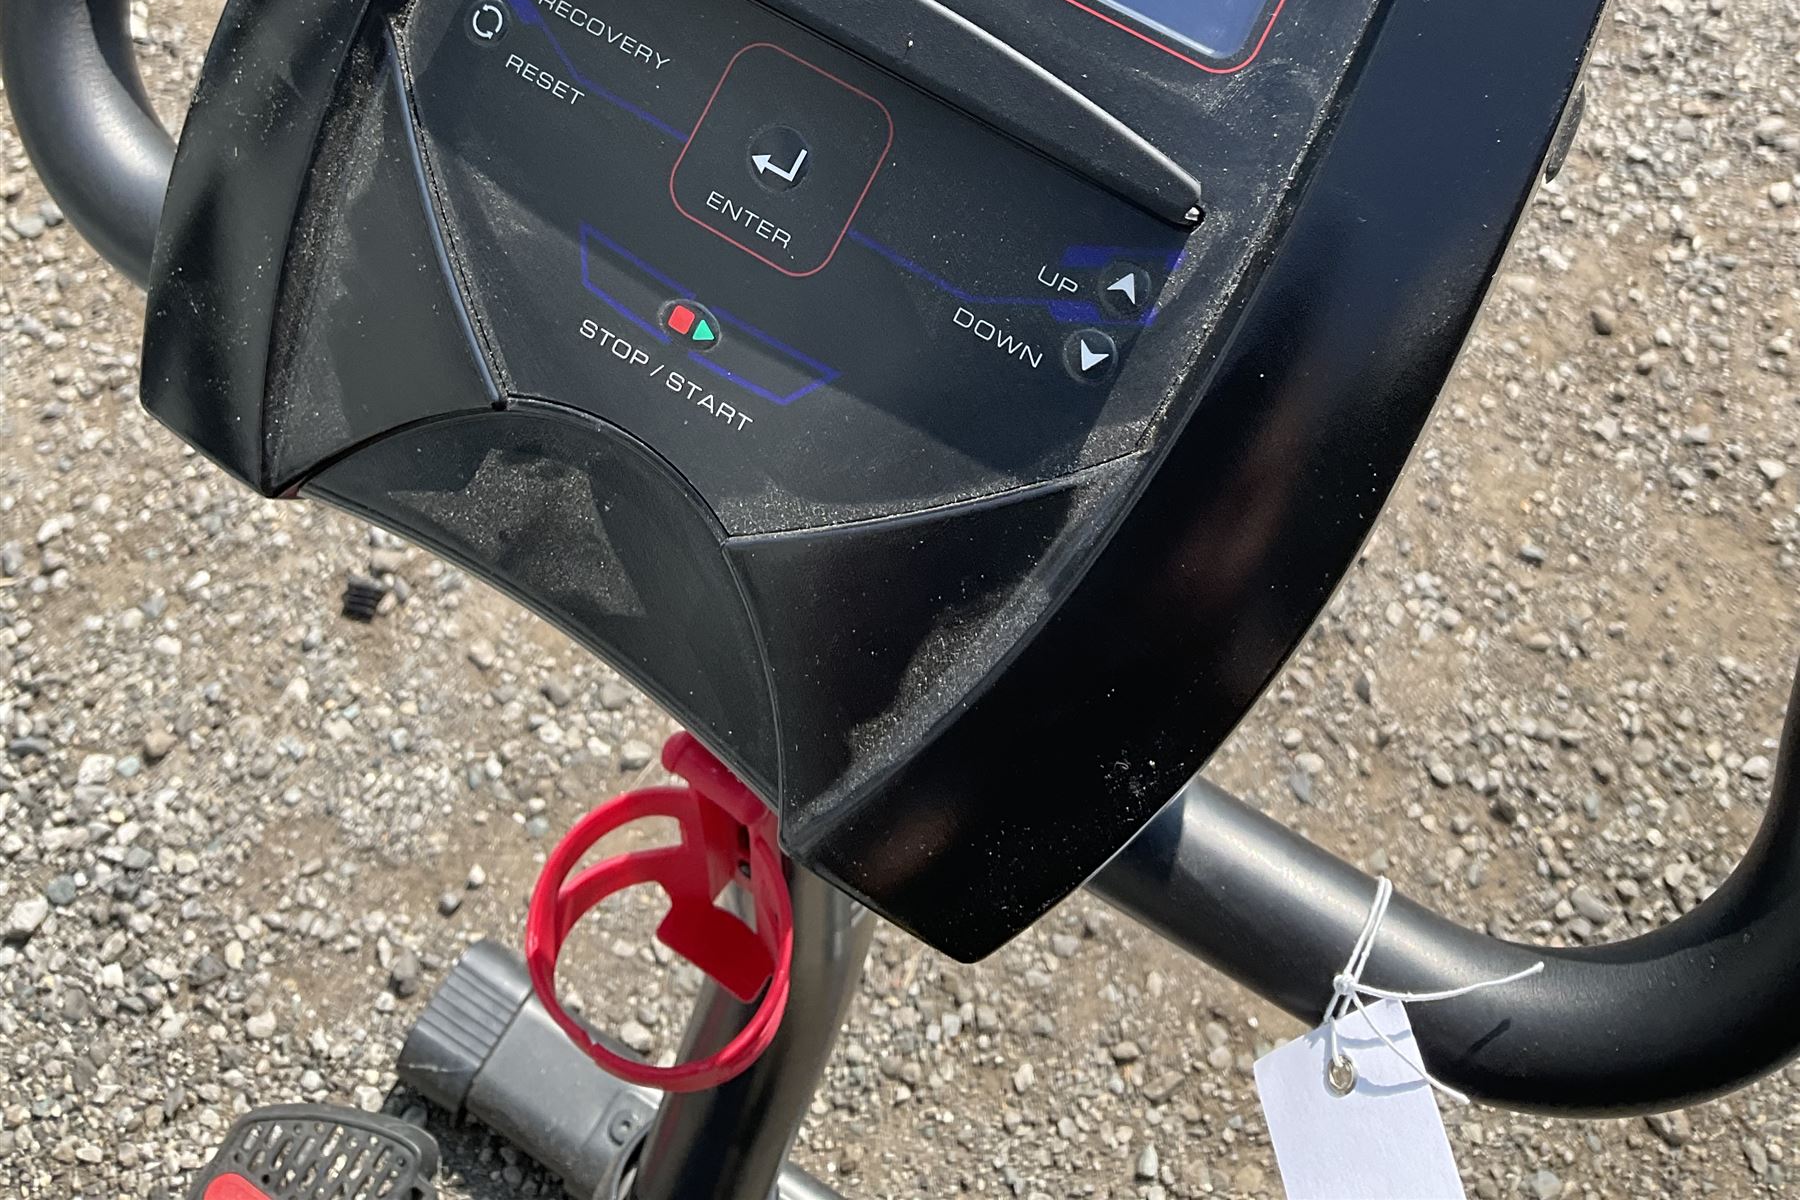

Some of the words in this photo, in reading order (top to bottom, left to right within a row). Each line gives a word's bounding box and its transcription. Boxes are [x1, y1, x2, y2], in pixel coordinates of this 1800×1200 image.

[505, 53, 585, 105] RESET
[706, 190, 792, 249] ENTER
[1037, 265, 1079, 293] UP
[952, 307, 1043, 368] DOWN
